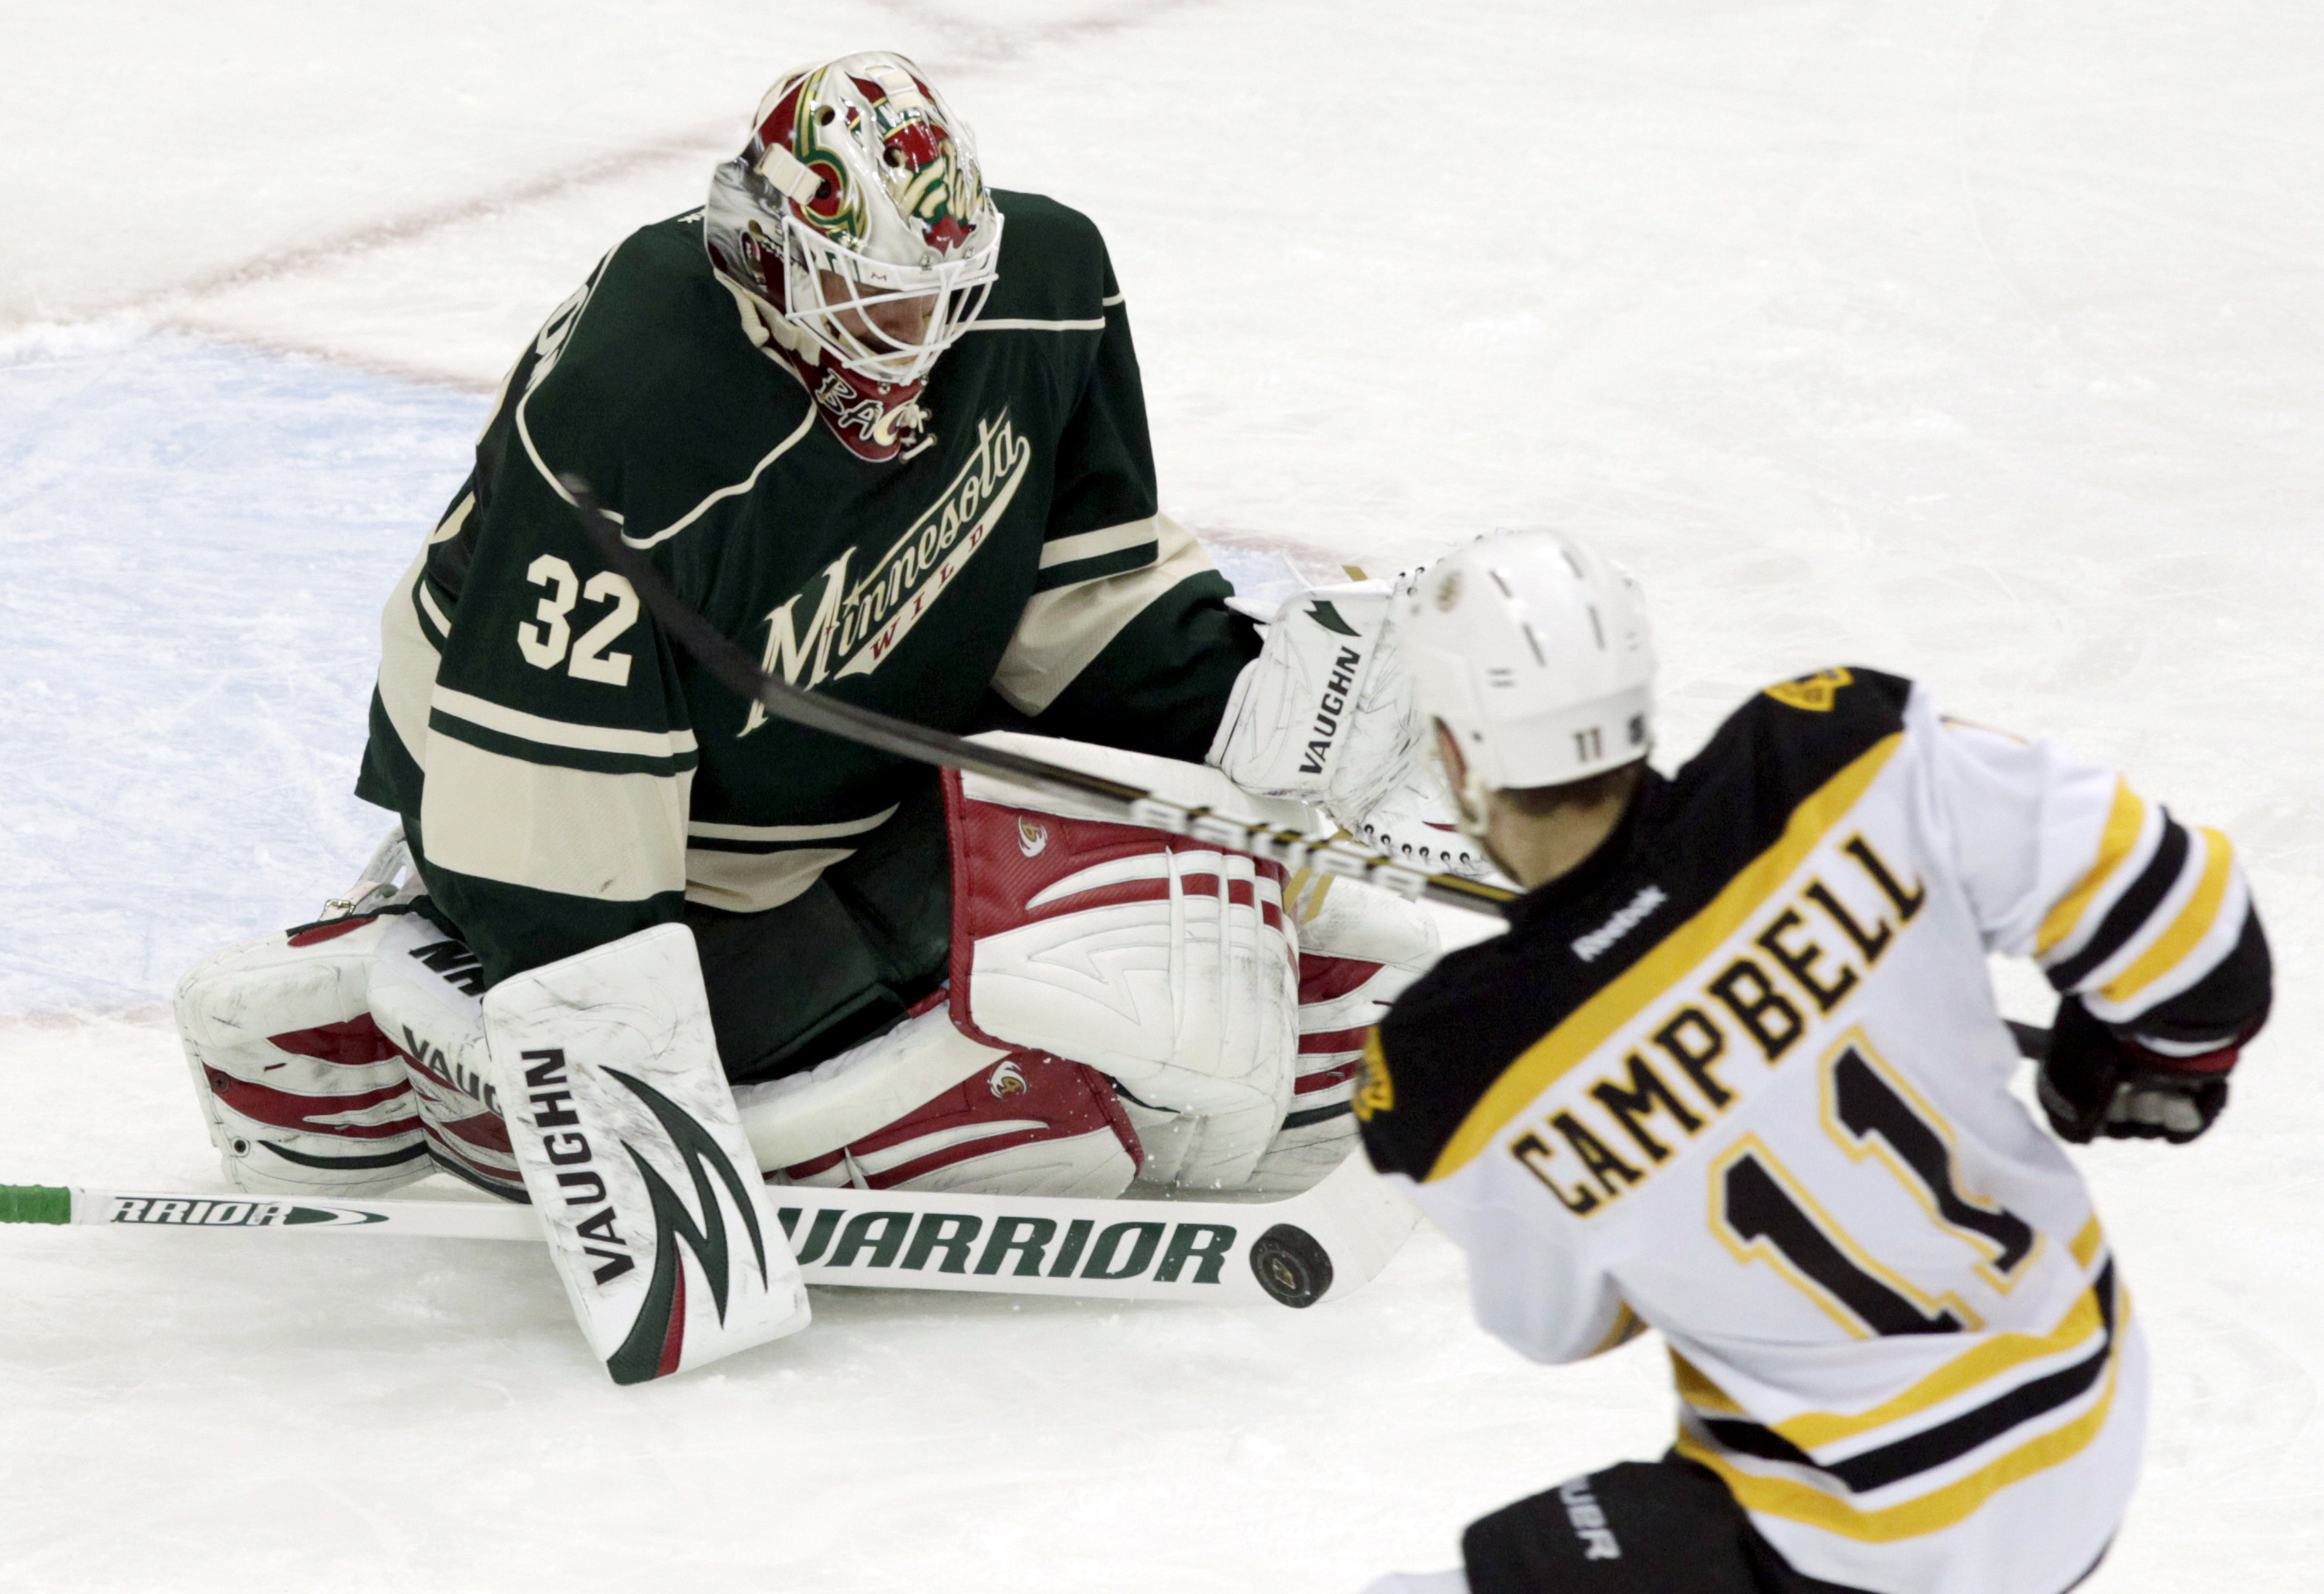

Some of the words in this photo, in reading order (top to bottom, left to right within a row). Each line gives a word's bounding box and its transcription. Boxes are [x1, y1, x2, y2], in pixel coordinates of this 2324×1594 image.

[517, 553, 639, 687] 32
[736, 407, 1030, 738] Minnesota
[869, 523, 983, 660] WILD
[1299, 645, 1362, 775] VAUGHN
[1573, 726, 1602, 763] 11
[1510, 835, 1926, 1220] CAMPBELL
[520, 1047, 636, 1287] VAUGHN
[1708, 1025, 2045, 1341] 11
